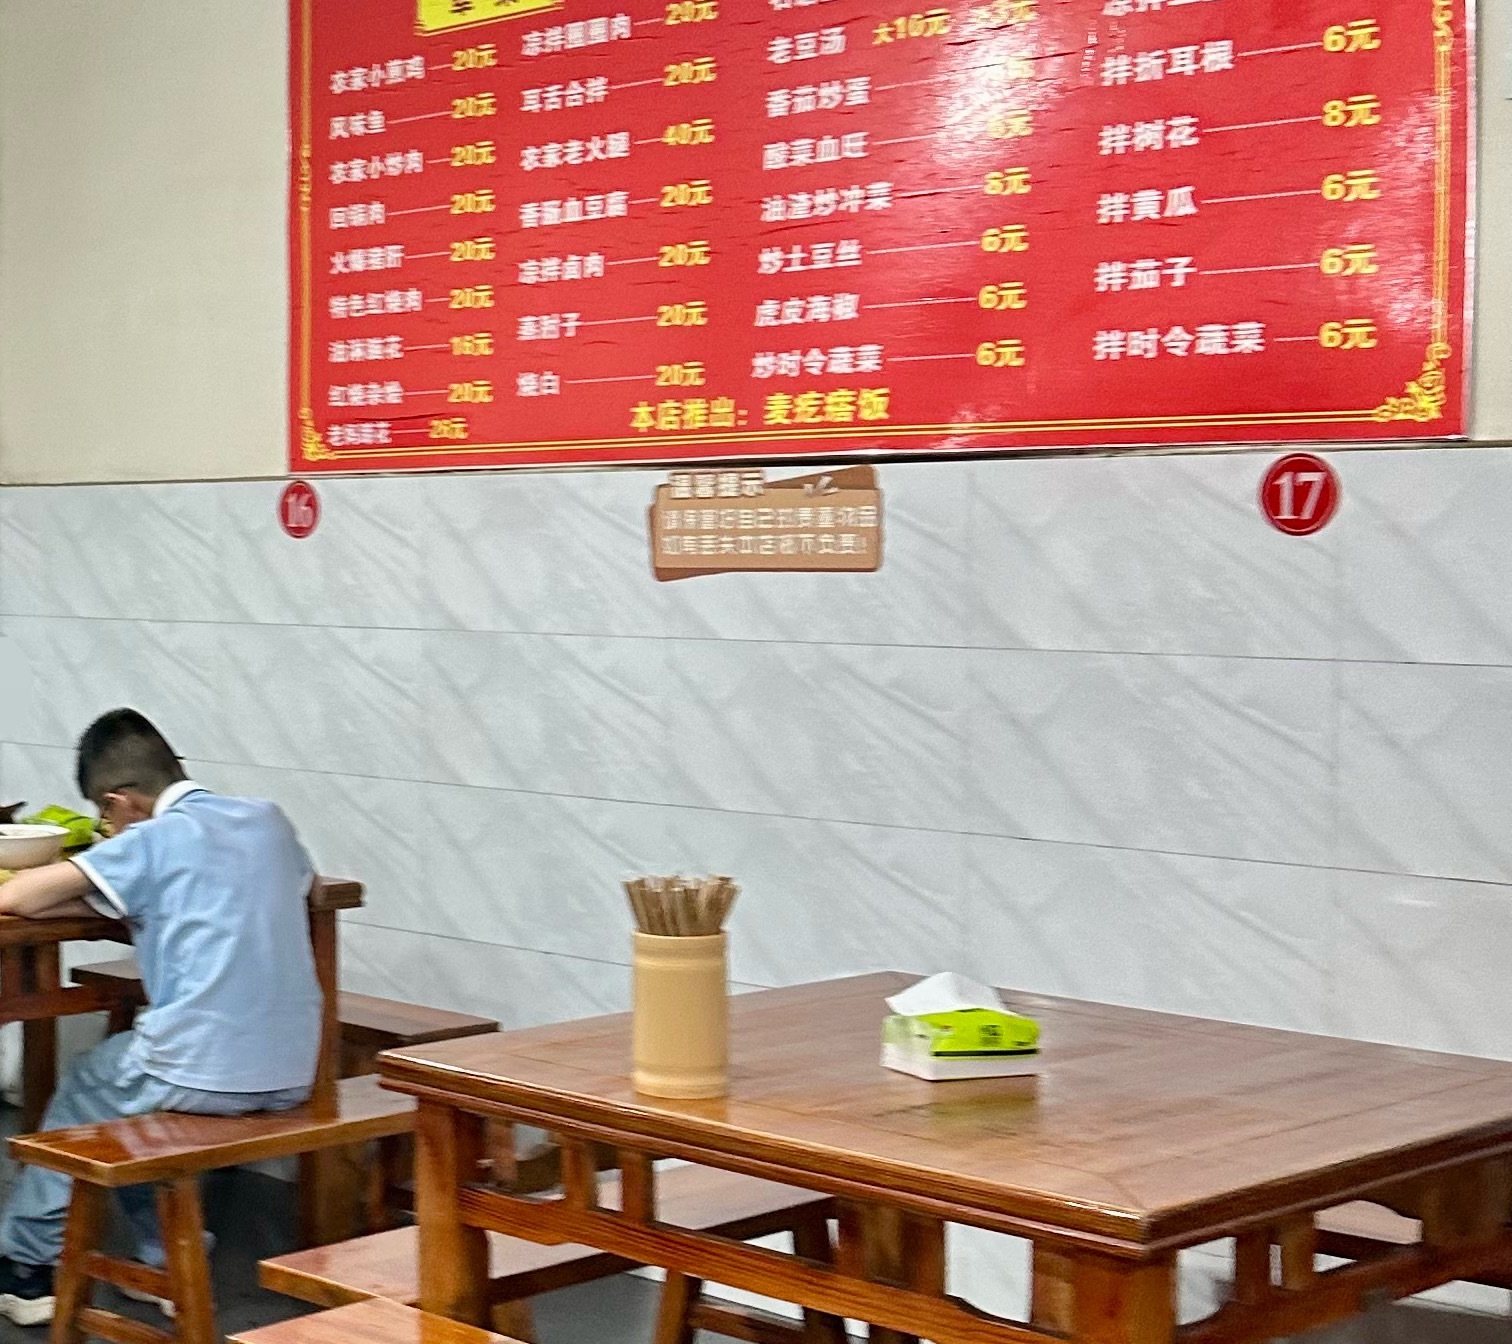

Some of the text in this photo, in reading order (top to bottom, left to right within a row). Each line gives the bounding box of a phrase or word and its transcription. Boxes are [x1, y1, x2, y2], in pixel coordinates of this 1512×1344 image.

[451, 44, 498, 71] 20元
[766, 27, 846, 64] 老豆汤
[1099, 19, 1382, 87] 拌折耳根 6元
[663, 57, 717, 86] 20元
[451, 92, 497, 119] 20元
[765, 76, 871, 118] 番茄炒蛋
[662, 119, 716, 147] 40元
[1098, 94, 1382, 156] 拌树花 8元
[450, 141, 496, 167] 20元
[762, 131, 870, 171] 酸菜血旺
[450, 189, 496, 215] 20元
[660, 180, 713, 208] 20元
[1096, 169, 1382, 225] 拌黄瓜 6元
[449, 237, 496, 262] 20元
[658, 240, 711, 267] 20元
[757, 224, 1030, 275] 炒土豆丝 6元
[1093, 243, 1379, 292] 拌茄子 6元
[448, 285, 495, 310] 20元
[754, 281, 1028, 327] 虎皮海椒 6元
[656, 301, 708, 327] 20元
[1092, 318, 1378, 361] 拌时令蔬菜 6元
[655, 361, 706, 387] 20元
[750, 339, 1026, 379] 炒时令蔬菜 6元
[447, 380, 494, 404] 20元
[285, 492, 315, 528] 16
[1271, 471, 1328, 520] 17
